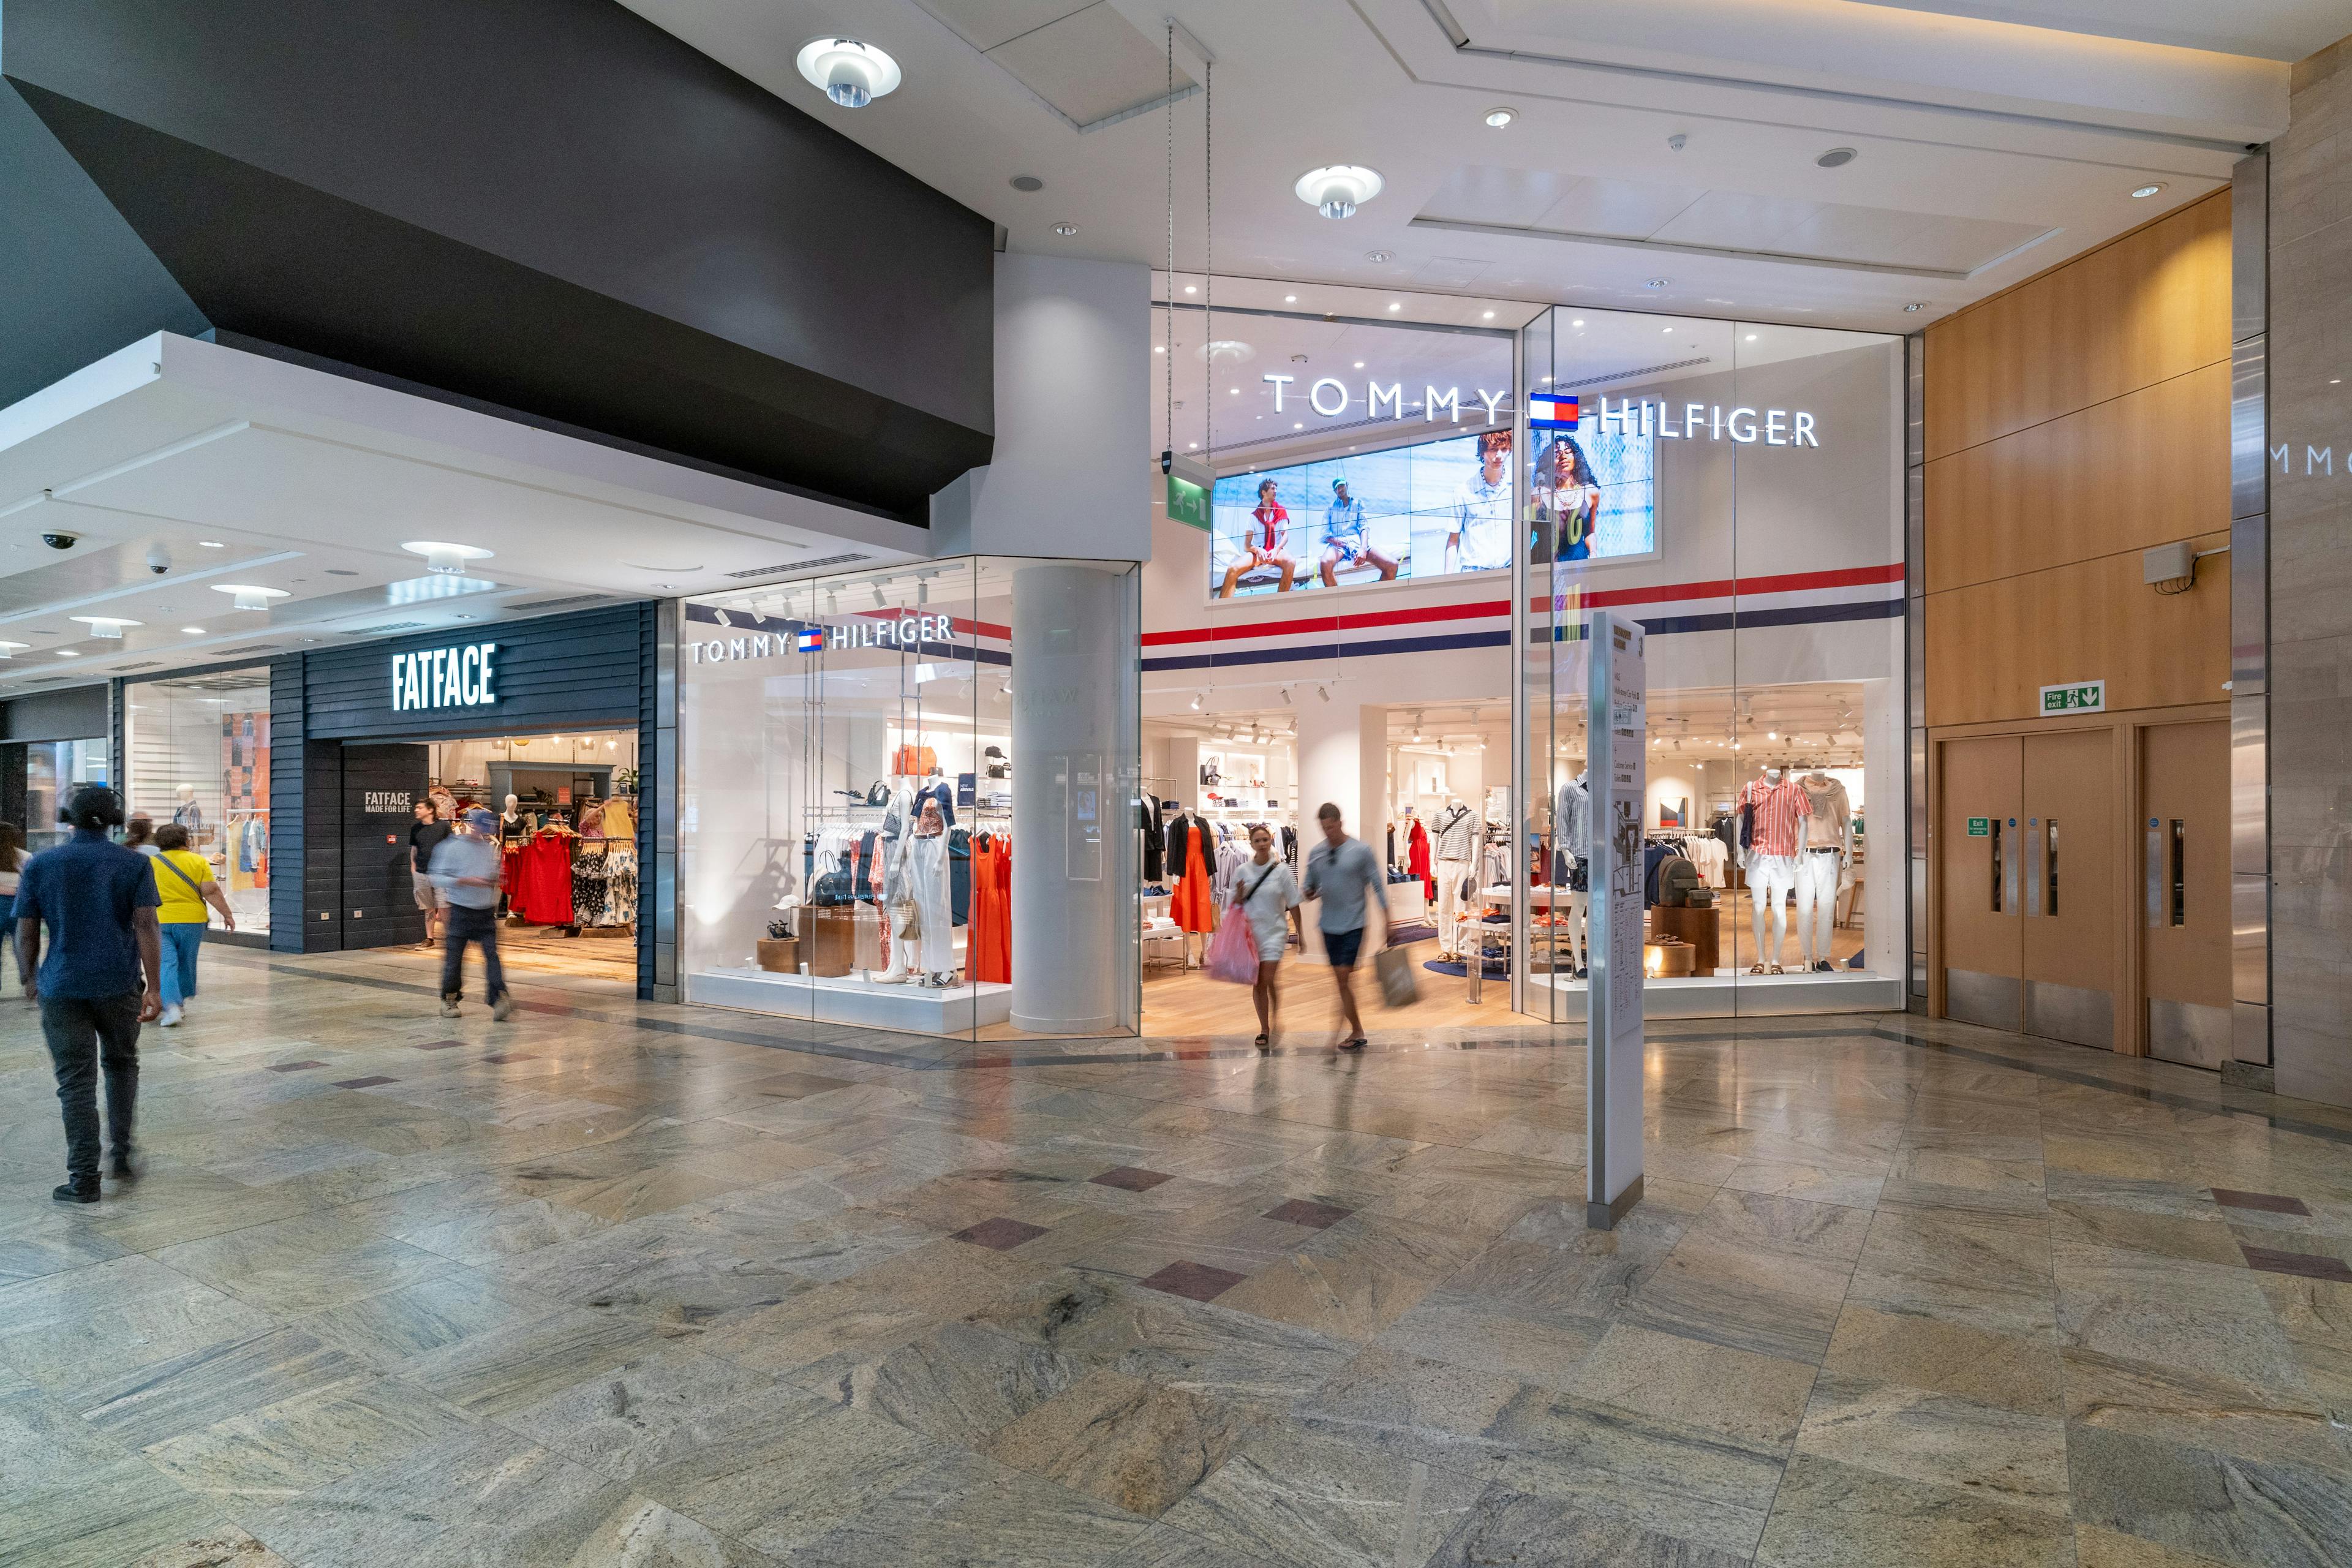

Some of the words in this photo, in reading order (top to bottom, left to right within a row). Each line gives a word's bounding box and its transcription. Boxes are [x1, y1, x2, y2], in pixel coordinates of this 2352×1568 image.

[1262, 374, 1506, 426] TOMMY
[1598, 396, 1819, 448] HILFIGER
[690, 632, 791, 663] TOMMY
[832, 615, 956, 650] HILFIGER
[1638, 636, 1643, 657] 3
[392, 642, 496, 711] FATFACE
[365, 791, 411, 805] FATFACE
